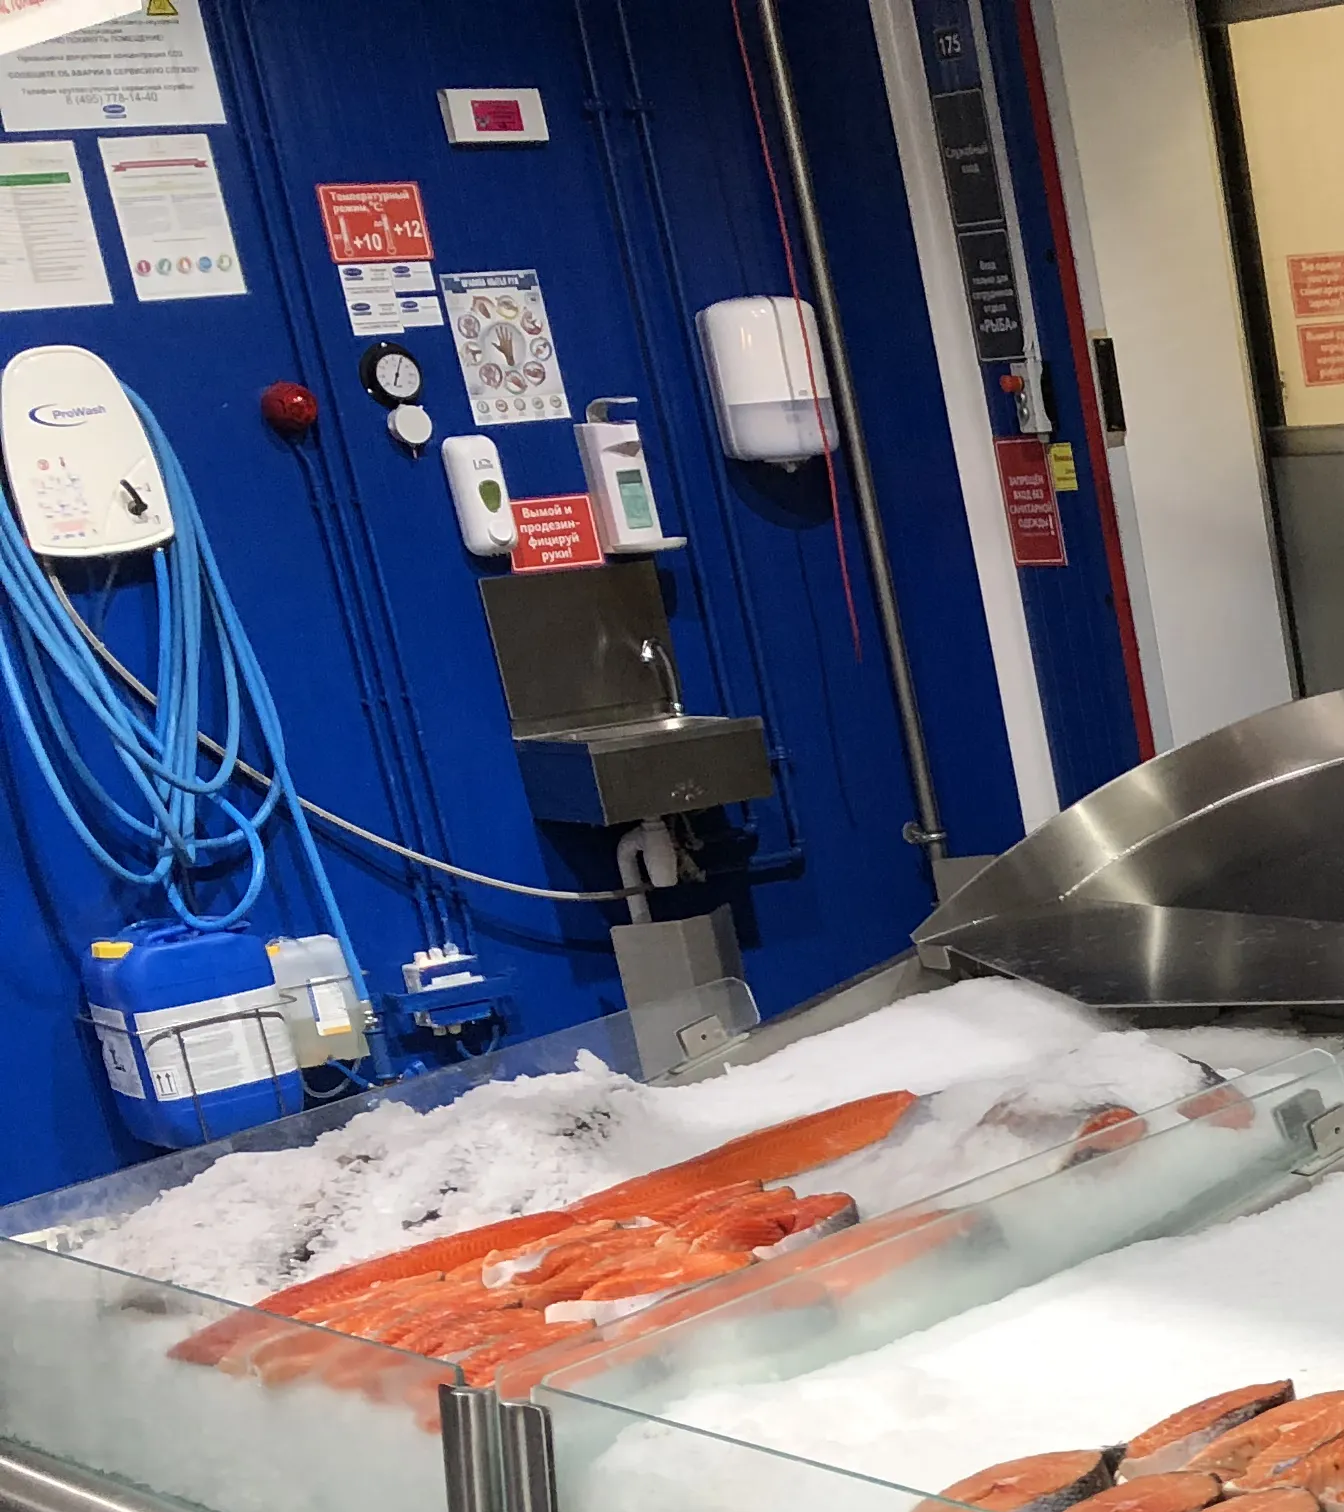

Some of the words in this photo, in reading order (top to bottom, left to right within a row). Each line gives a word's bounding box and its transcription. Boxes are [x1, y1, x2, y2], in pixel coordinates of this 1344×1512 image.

[939, 33, 962, 56] 175
[330, 190, 409, 203] Температурный
[393, 220, 424, 238] +12
[353, 233, 383, 251] +10
[51, 404, 107, 420] ProWash
[522, 504, 562, 518] Вымой
[564, 506, 572, 514] и
[520, 520, 580, 535] продезин-
[528, 532, 580, 549] фицируй
[541, 547, 572, 563] руки!
